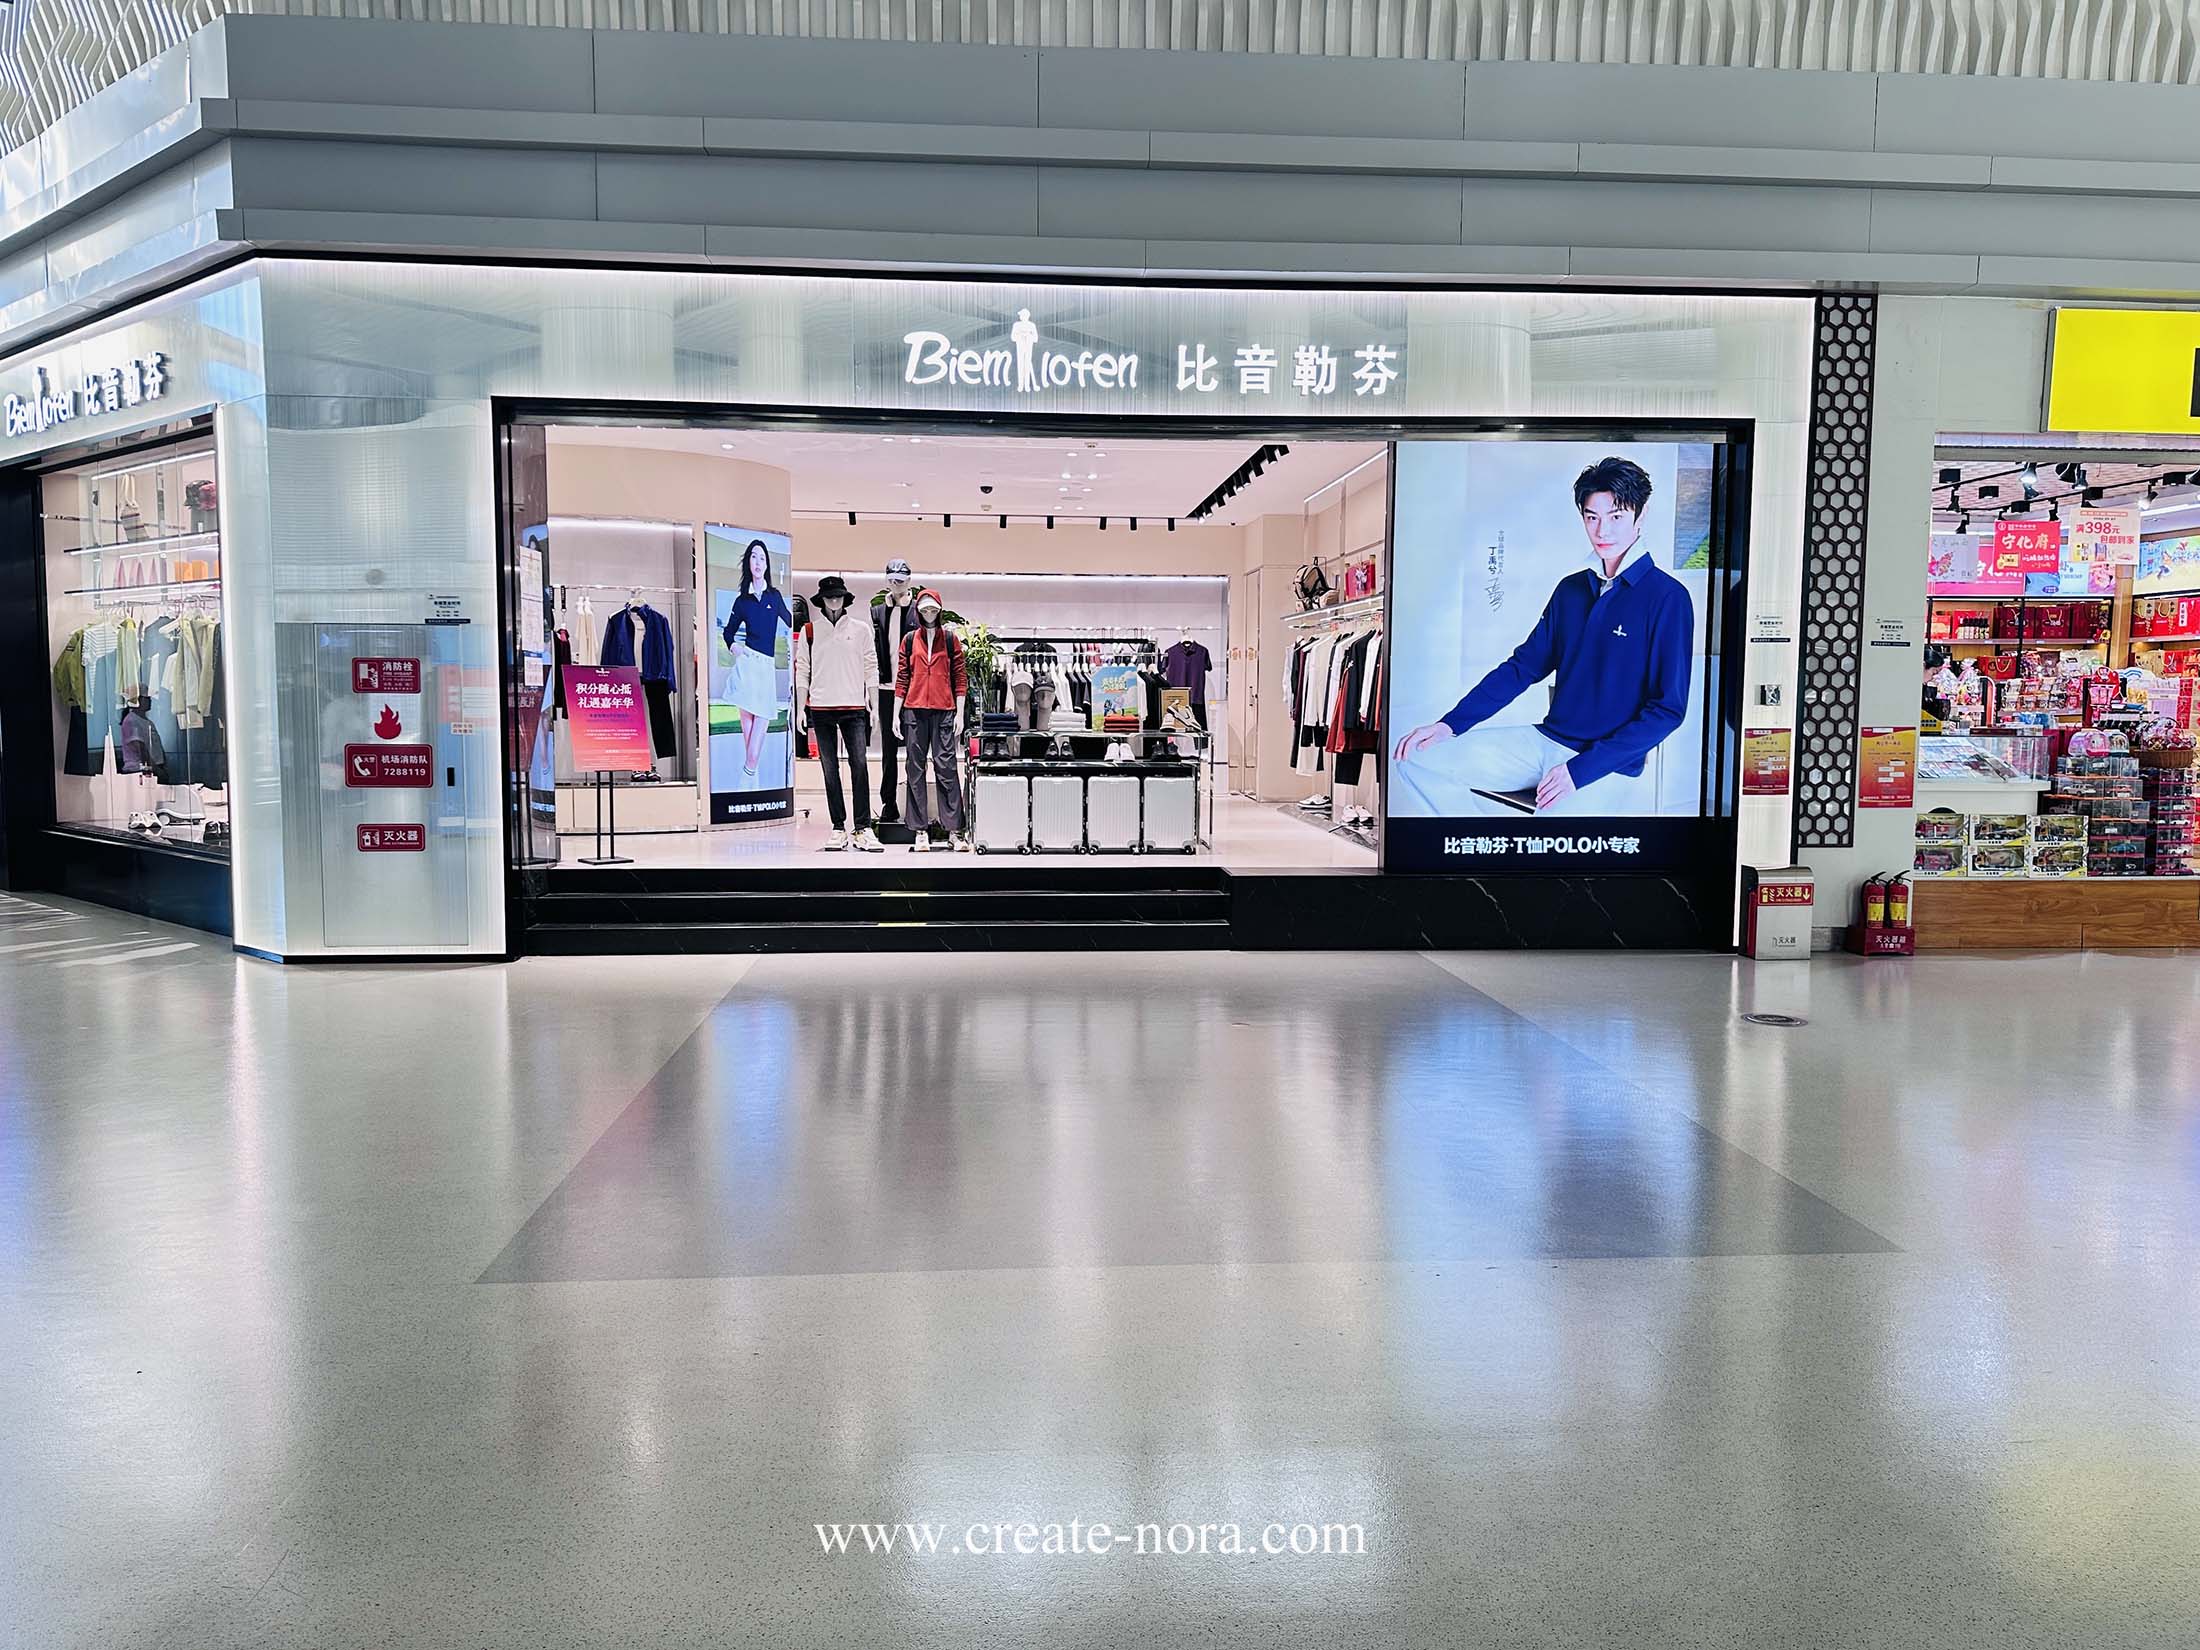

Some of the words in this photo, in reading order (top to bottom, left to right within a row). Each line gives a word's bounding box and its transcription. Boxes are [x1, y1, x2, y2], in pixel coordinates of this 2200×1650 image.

[1176, 343, 1399, 396] 比音勒芬
[83, 352, 163, 416] 比音勒芬
[2001, 532, 2049, 550] 宁化府
[2100, 535, 2135, 545] 包邮到家
[382, 661, 414, 672] 消防栓
[575, 682, 633, 696] 积分随心抵
[577, 696, 635, 709] 礼遇嘉年华
[381, 754, 429, 765] 机场消防队
[383, 768, 427, 776] 7288119
[383, 830, 419, 841] 灭火器
[1443, 836, 1641, 855] 比音勒芬·T恤POLO小专家
[1776, 887, 1802, 898] 灭火器
